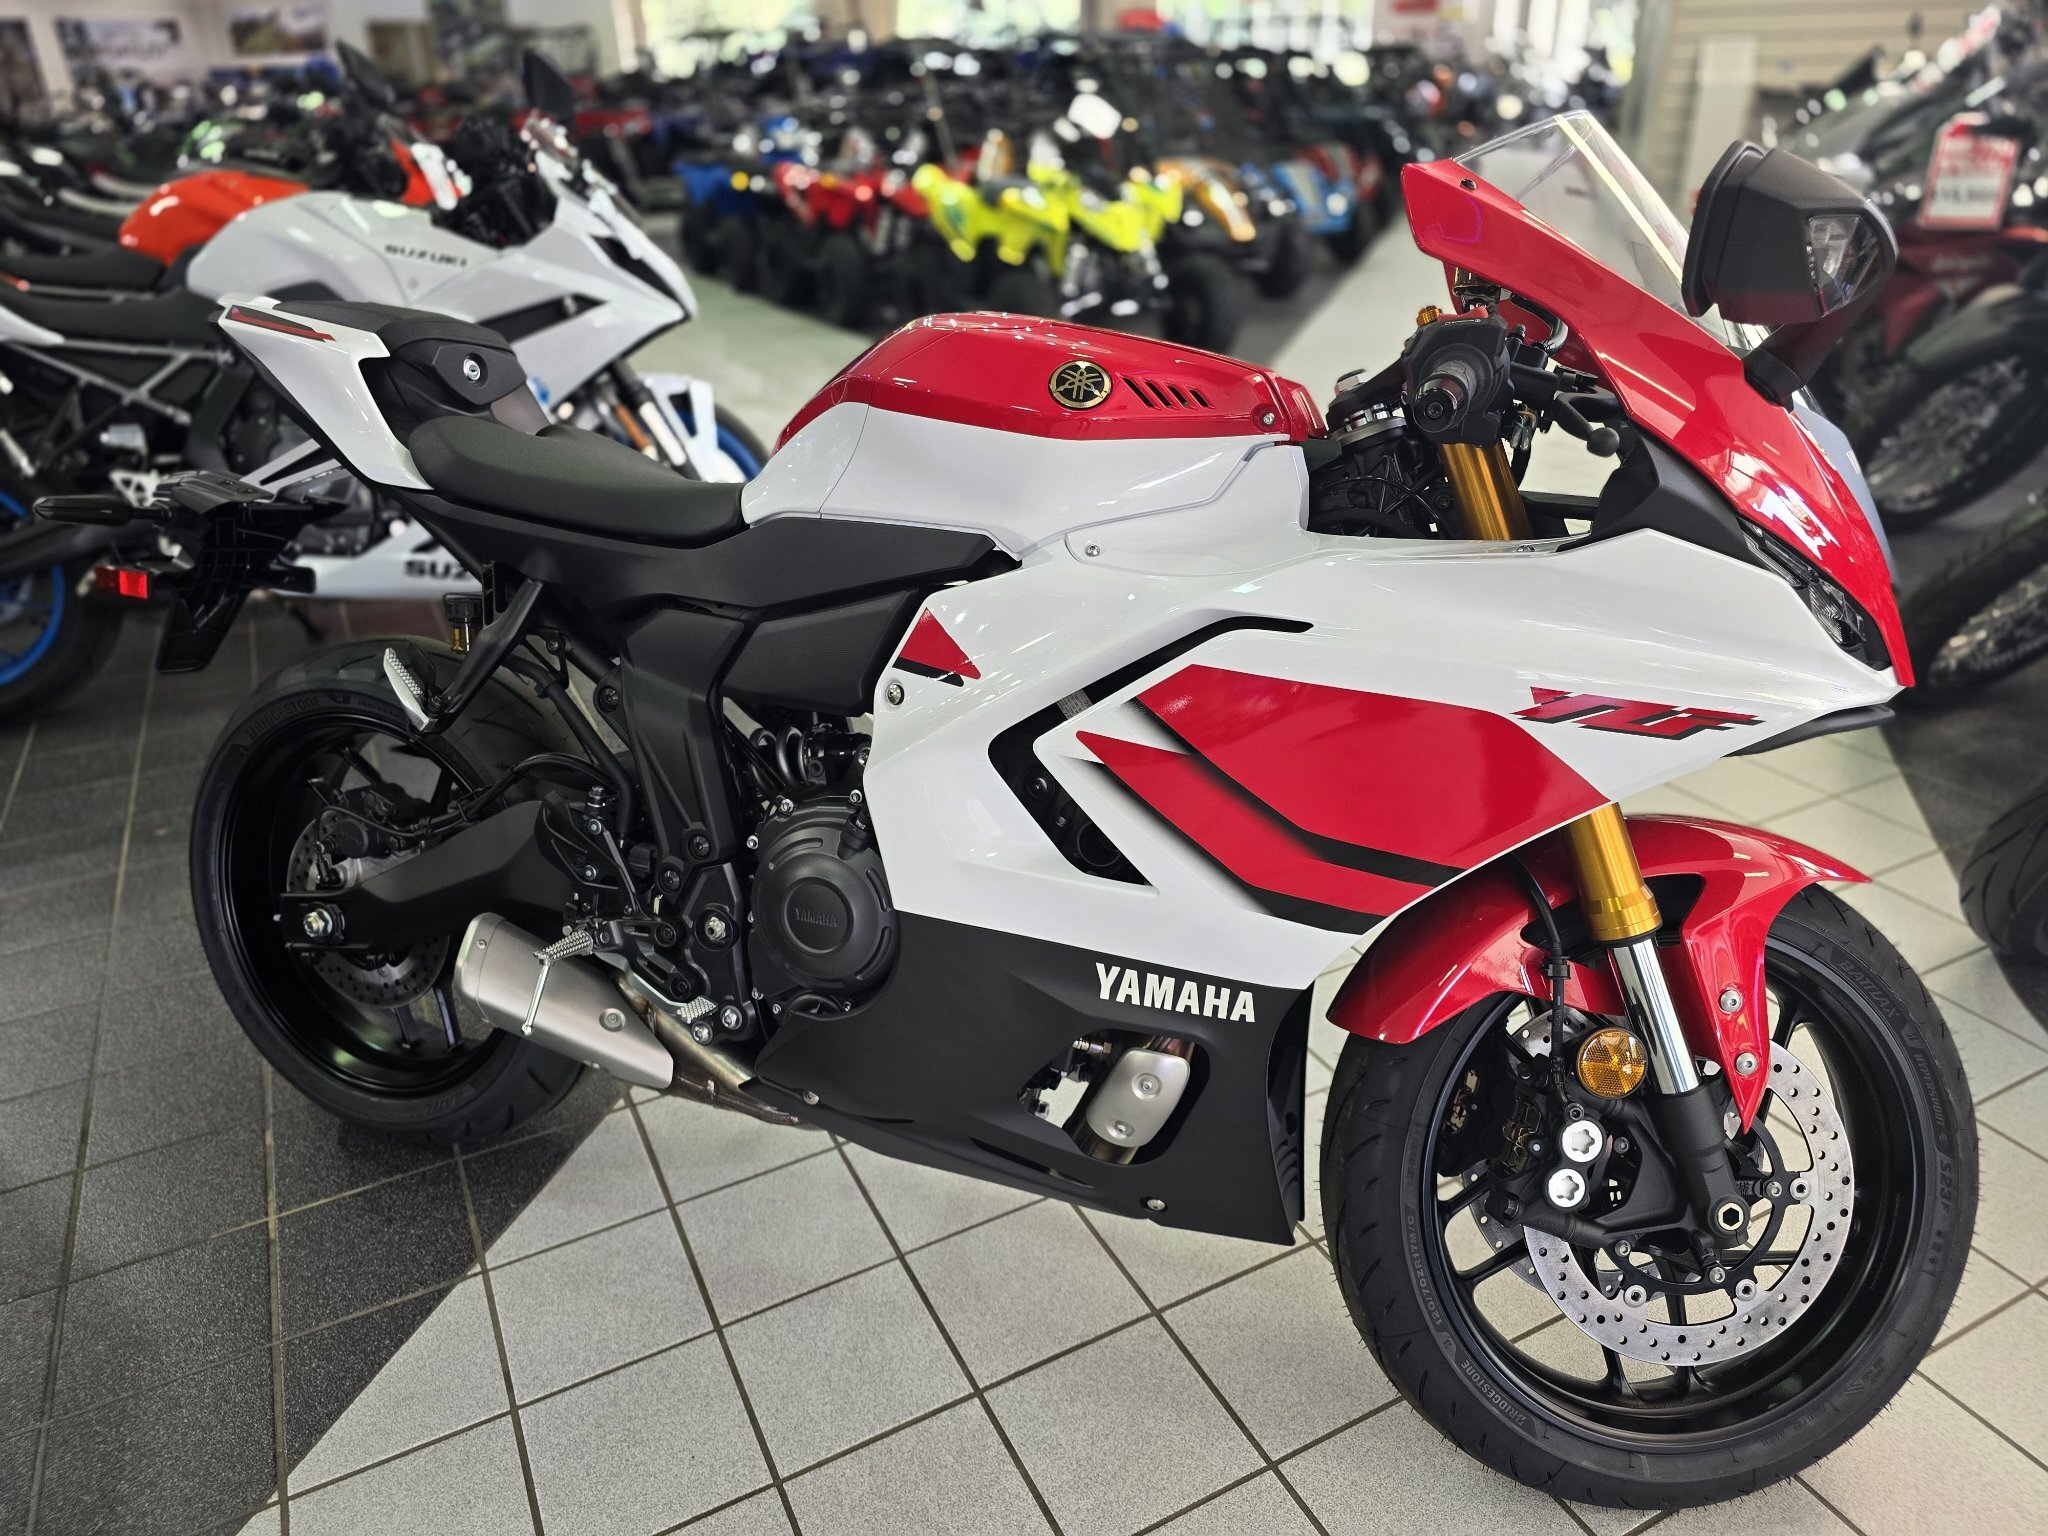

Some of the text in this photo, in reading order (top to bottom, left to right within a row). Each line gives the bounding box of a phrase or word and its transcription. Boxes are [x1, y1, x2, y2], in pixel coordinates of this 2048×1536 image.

[385, 244, 467, 267] SUZUKI
[404, 560, 472, 580] SUZ
[795, 906, 839, 928] YAMAHA
[1095, 962, 1255, 1023] YAMAHA
[1839, 960, 1900, 1019] BATTLAX
[1460, 1359, 1527, 1427] BRIDGESTONE
